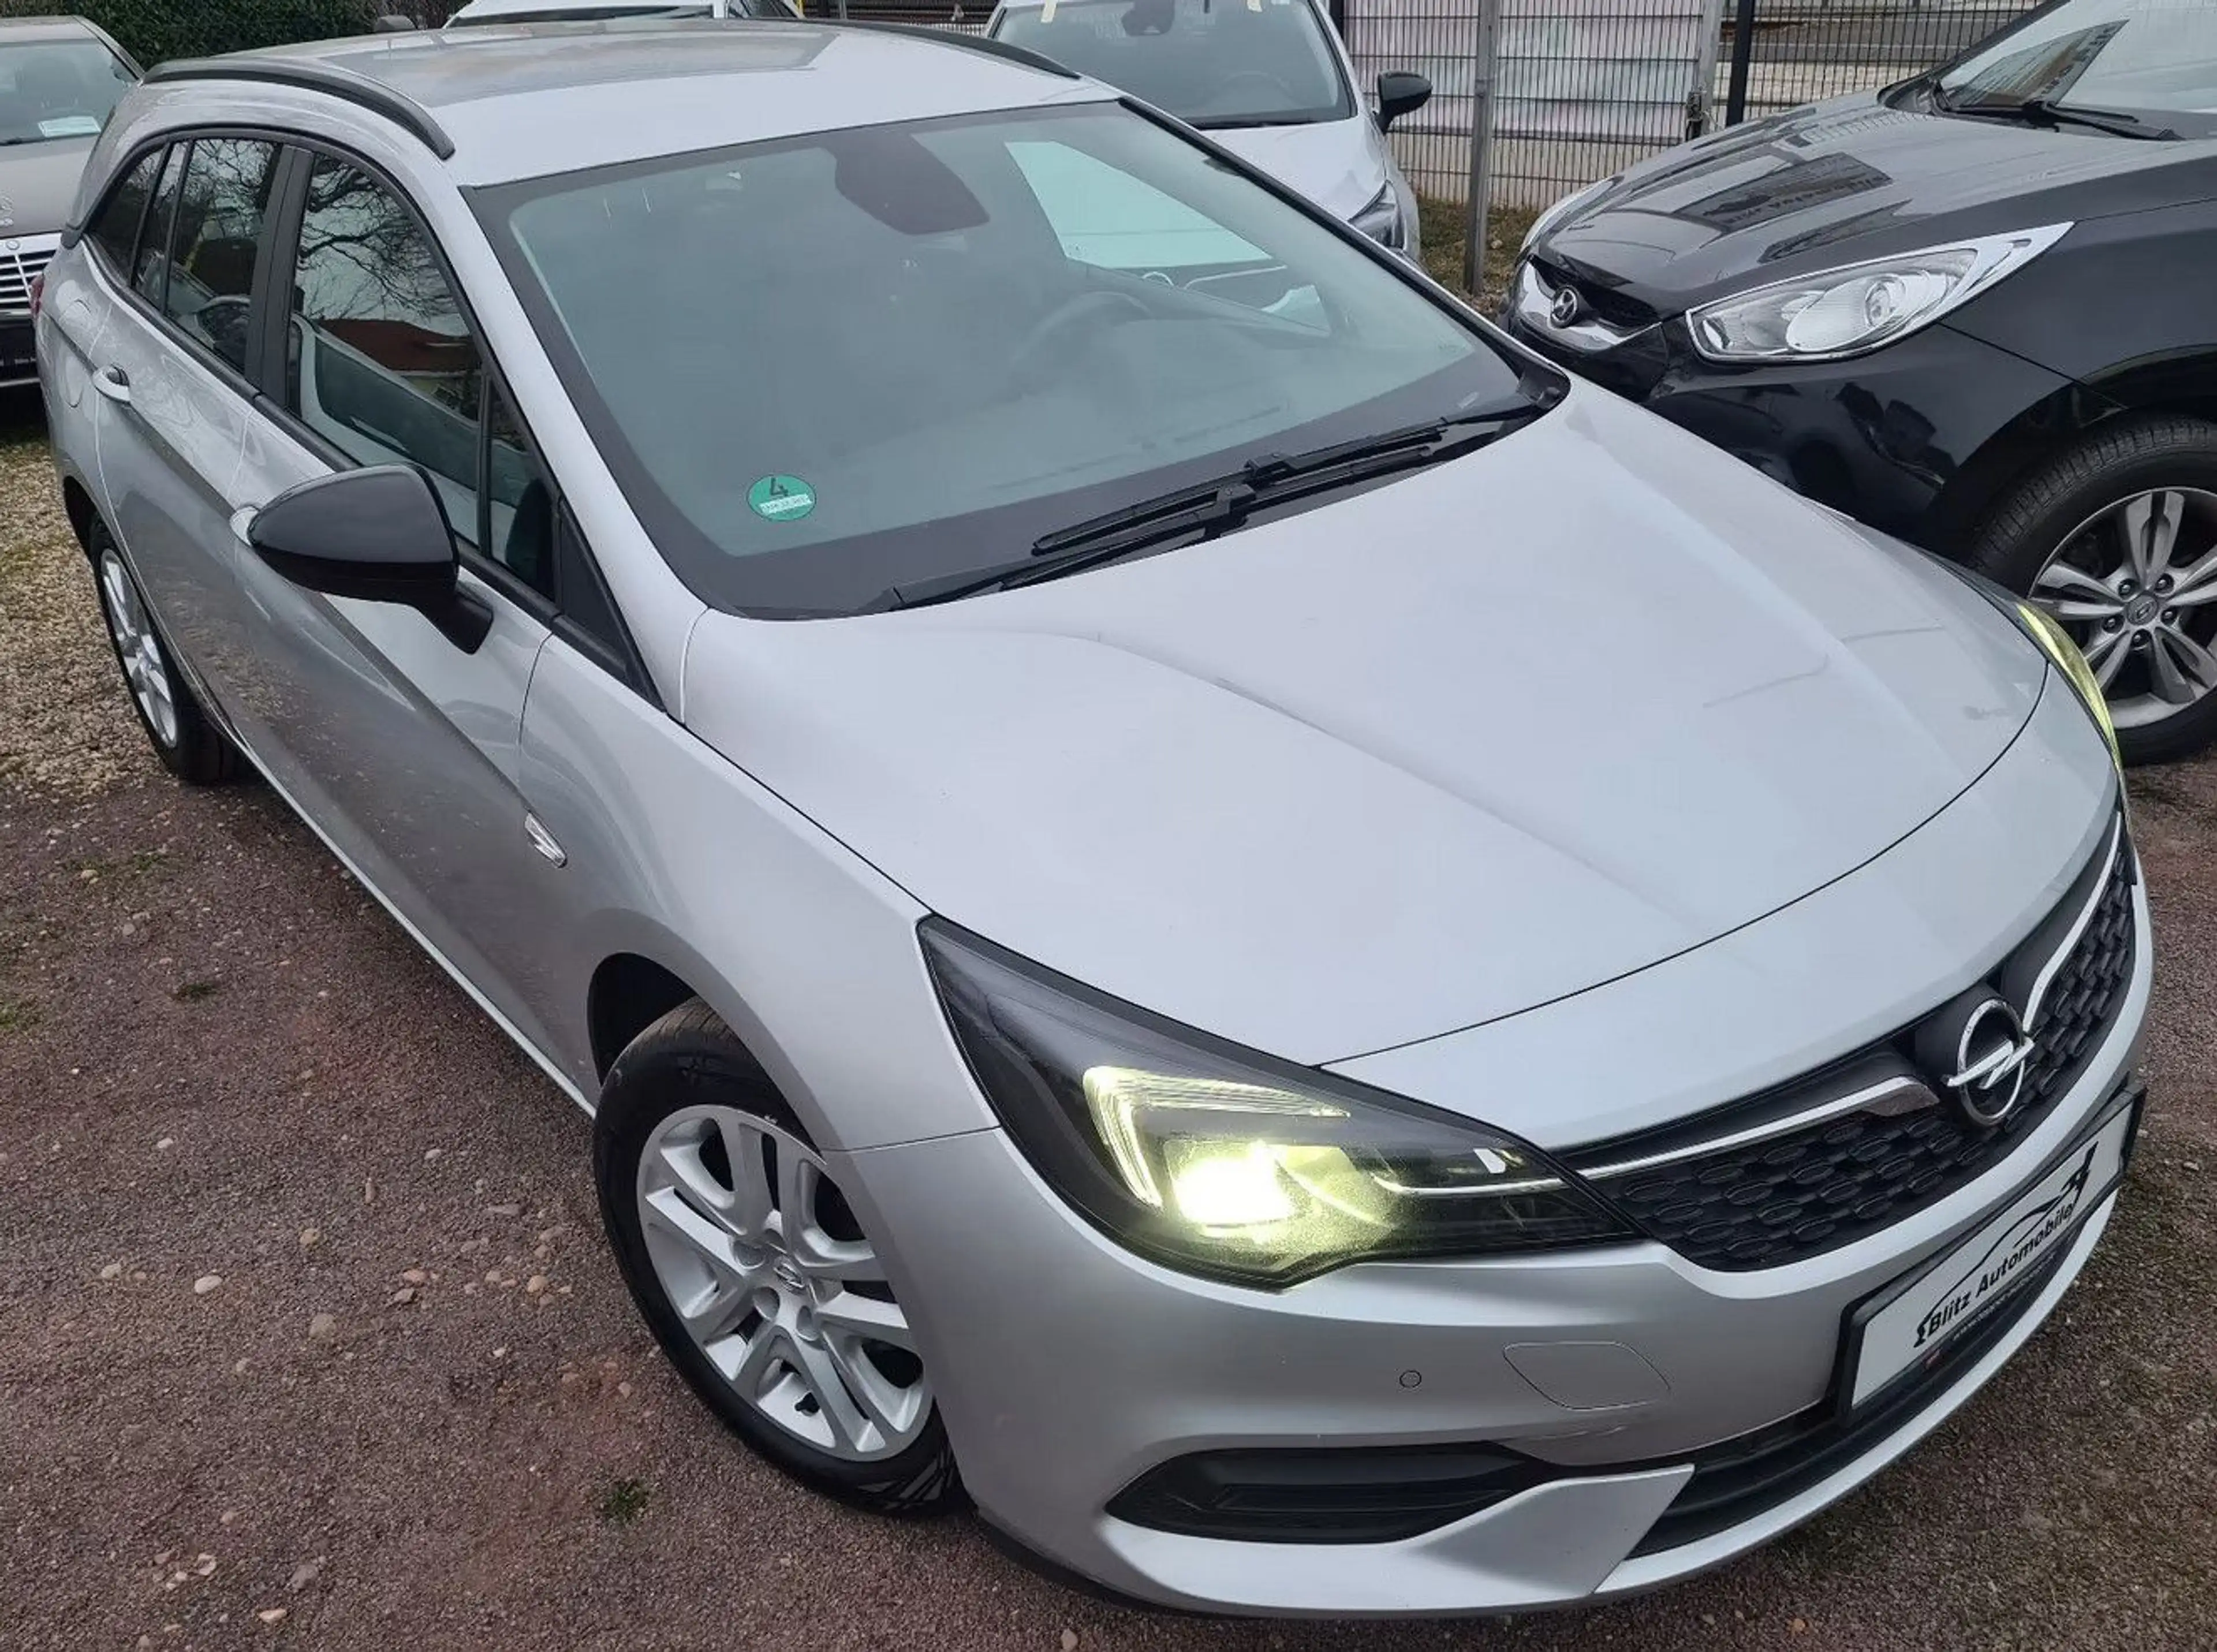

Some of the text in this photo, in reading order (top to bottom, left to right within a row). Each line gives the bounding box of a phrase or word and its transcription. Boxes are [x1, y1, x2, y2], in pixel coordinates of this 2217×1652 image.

[769, 476, 789, 497] 4
[1927, 1291, 1971, 1337] Blitz
[1975, 1203, 2074, 1298] Automobile
